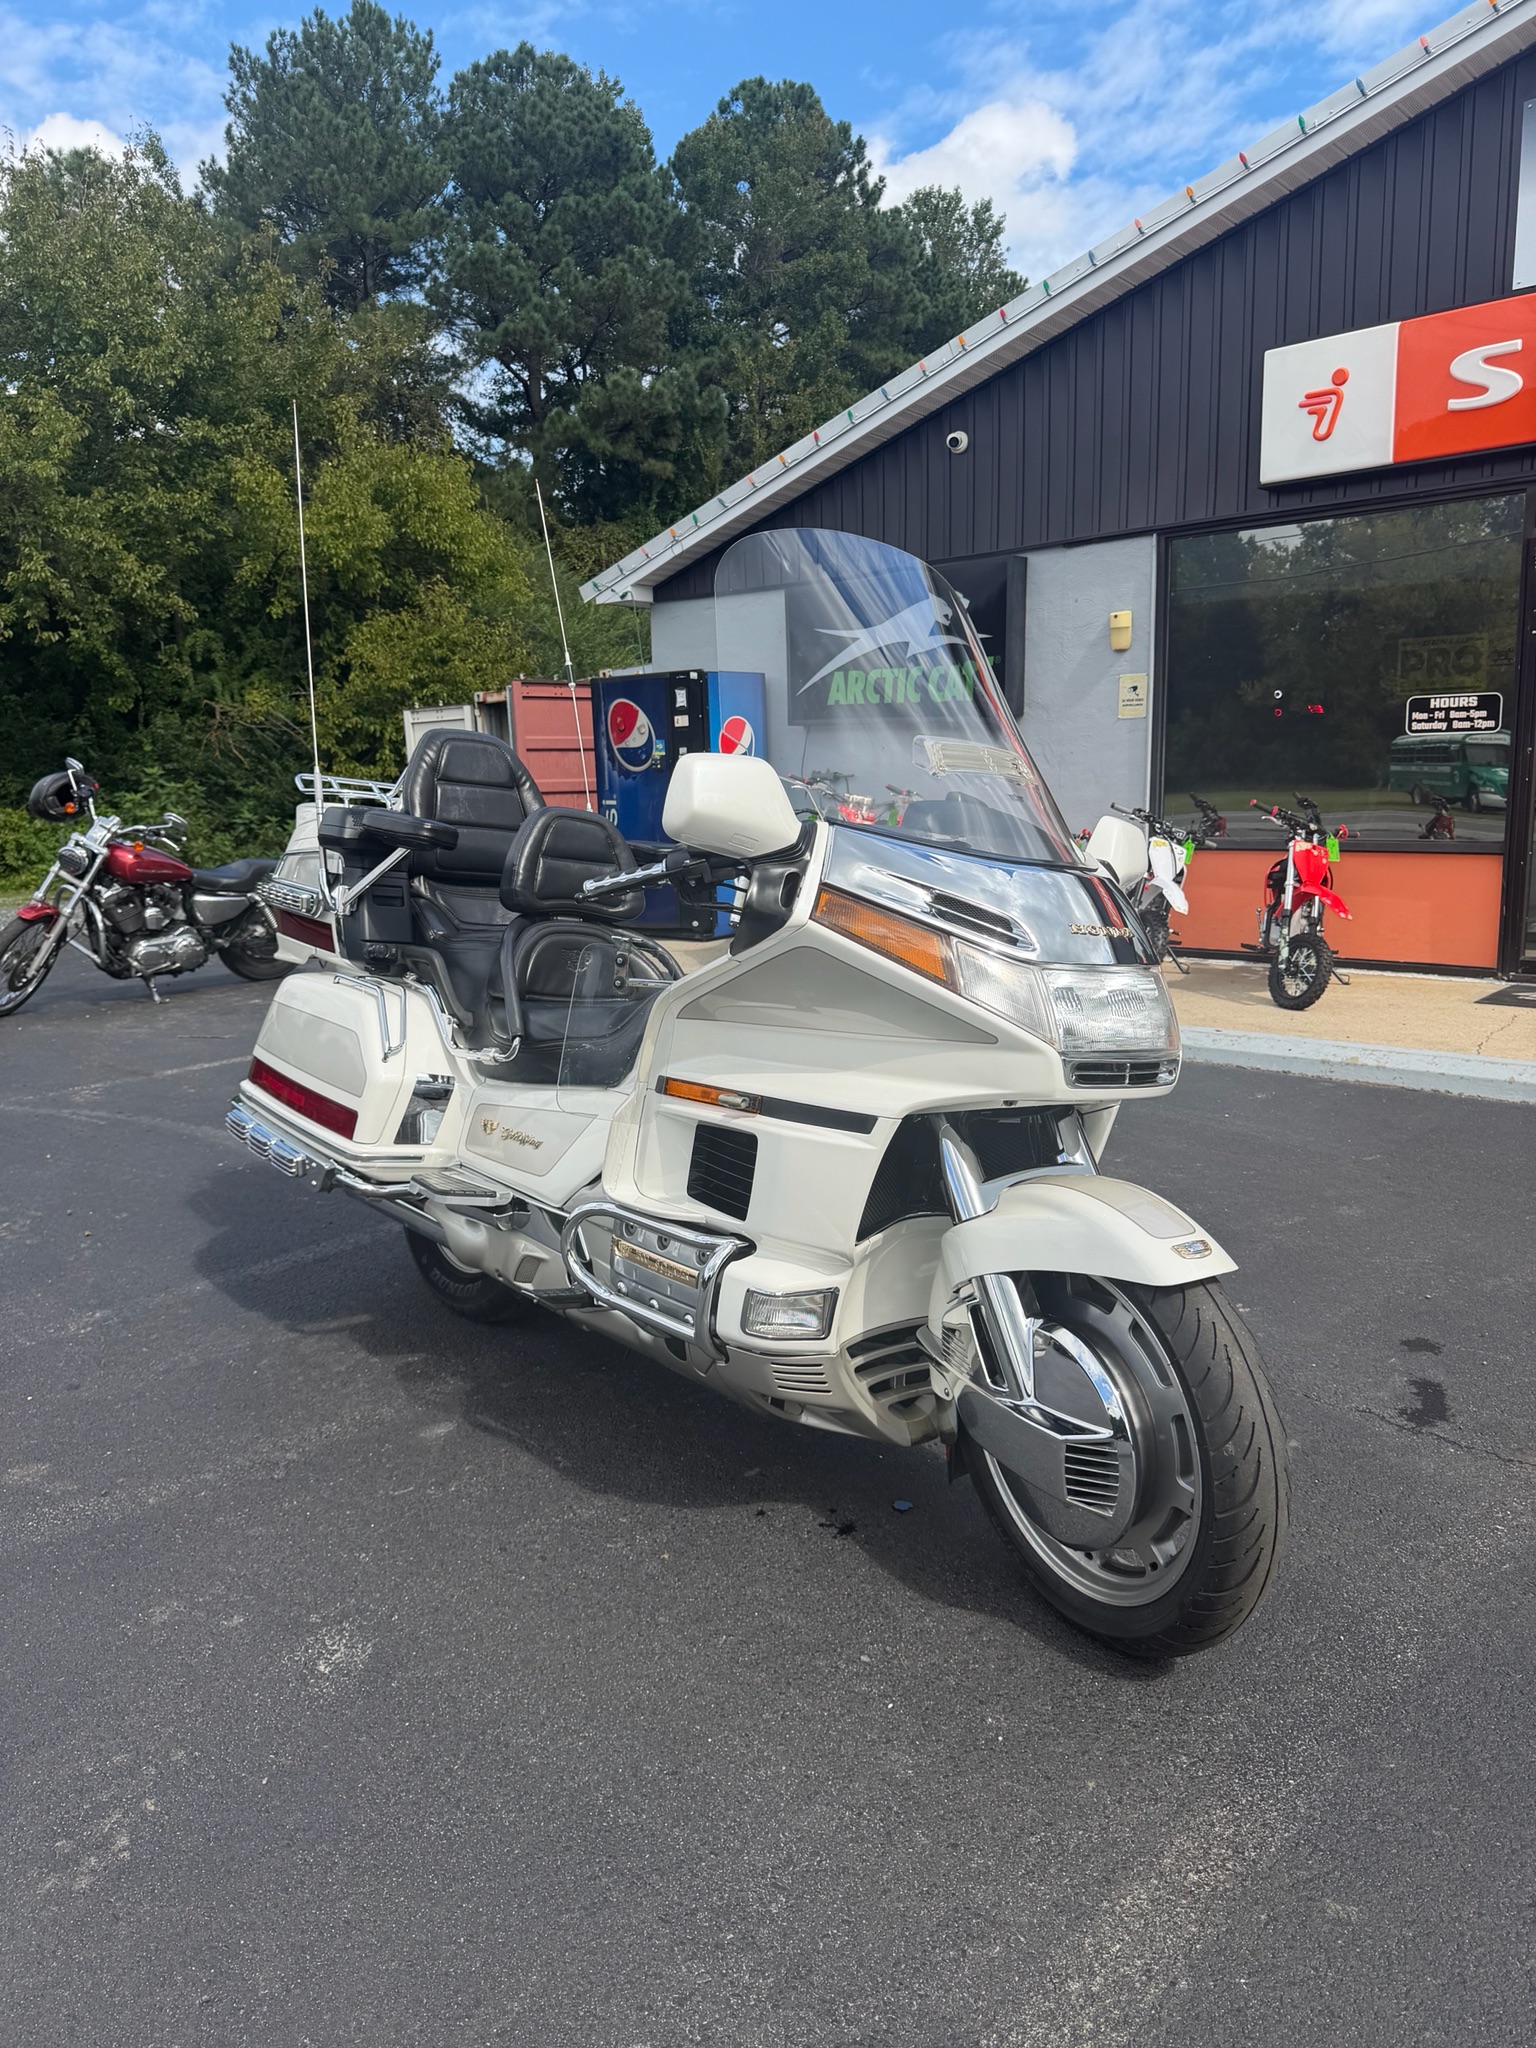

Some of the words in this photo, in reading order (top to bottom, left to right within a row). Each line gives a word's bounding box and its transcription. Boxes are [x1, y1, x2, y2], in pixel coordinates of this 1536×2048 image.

[1447, 338, 1524, 412] S
[1400, 645, 1484, 679] PRO
[827, 668, 923, 705] ARCTIC
[1430, 697, 1478, 709] HOURS
[1411, 711, 1428, 720] Mon
[1434, 710, 1445, 719] Fri
[1411, 721, 1448, 731] Saturday
